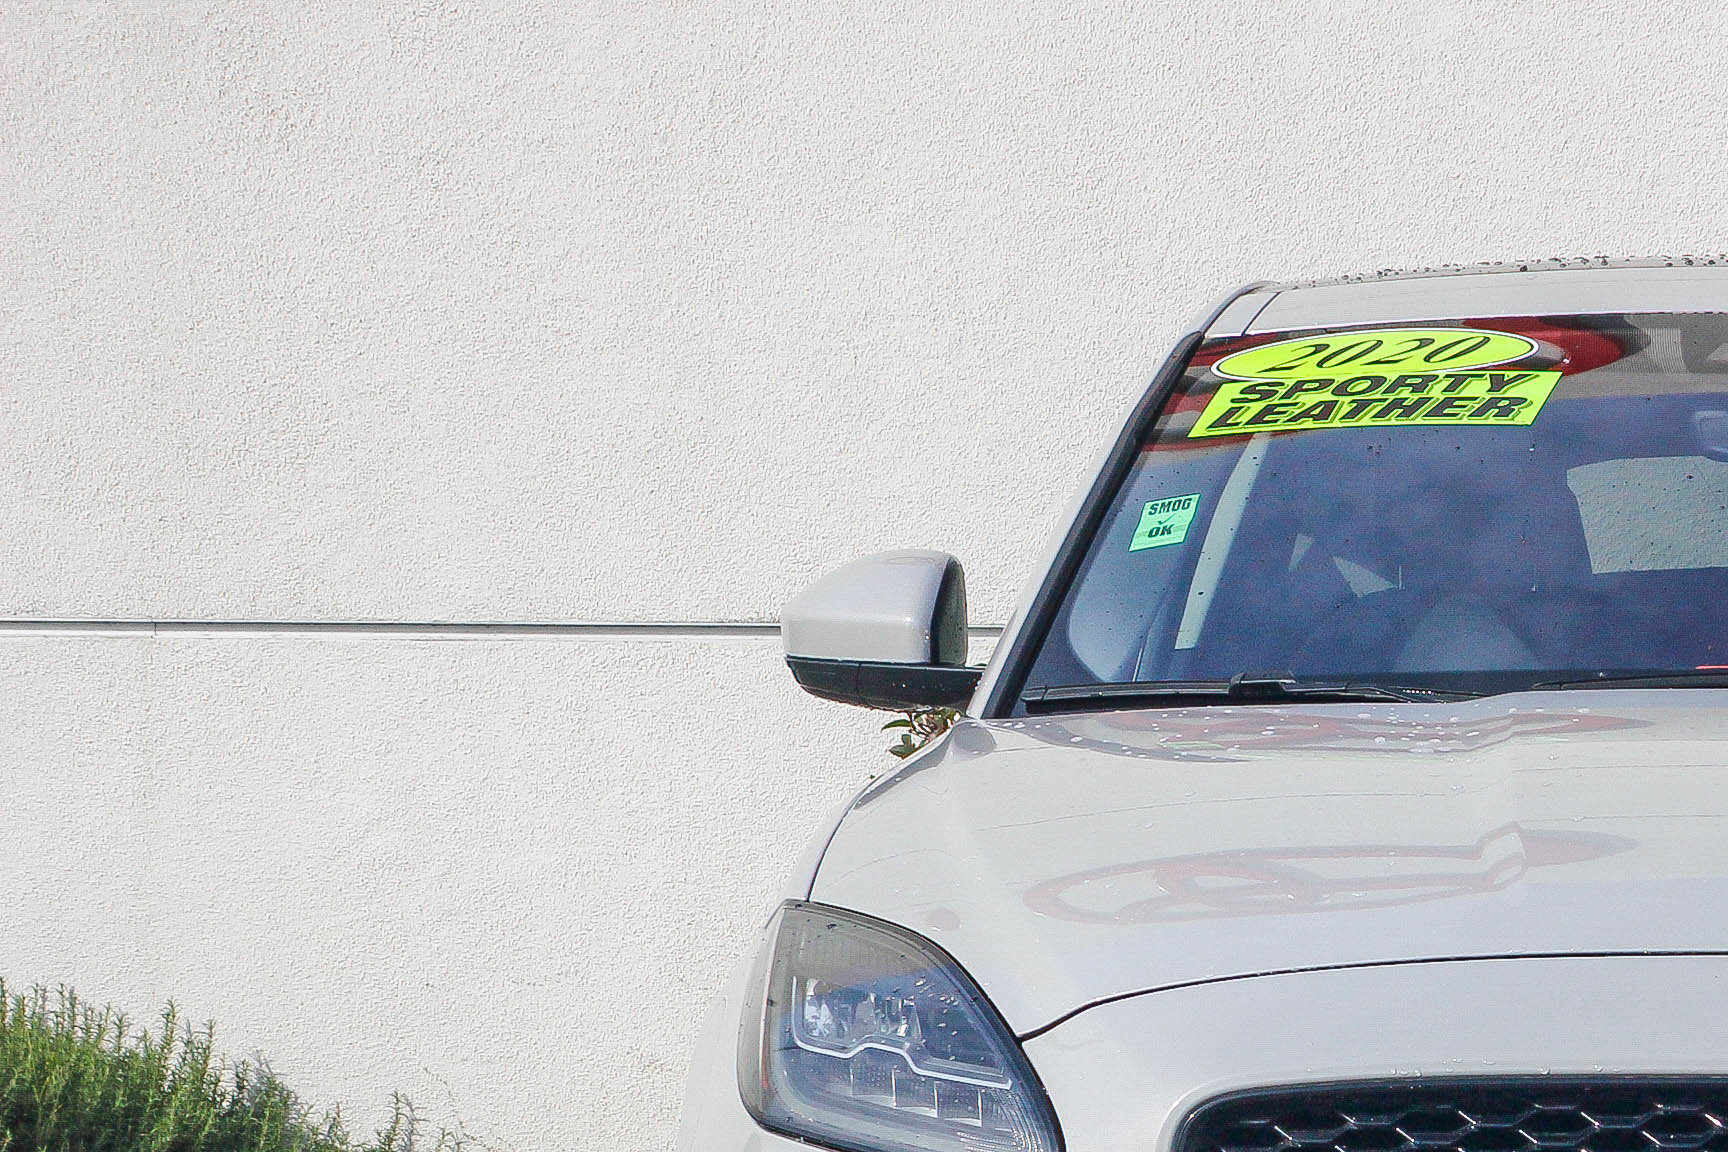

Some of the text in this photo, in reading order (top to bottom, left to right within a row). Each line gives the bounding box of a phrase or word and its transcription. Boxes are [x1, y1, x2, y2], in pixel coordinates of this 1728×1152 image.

[1266, 335, 1491, 373] 2020
[1230, 373, 1531, 403] SPORTY
[1207, 396, 1530, 427] LEATHER
[1148, 498, 1192, 515] SMOG
[1147, 524, 1175, 538] OK
